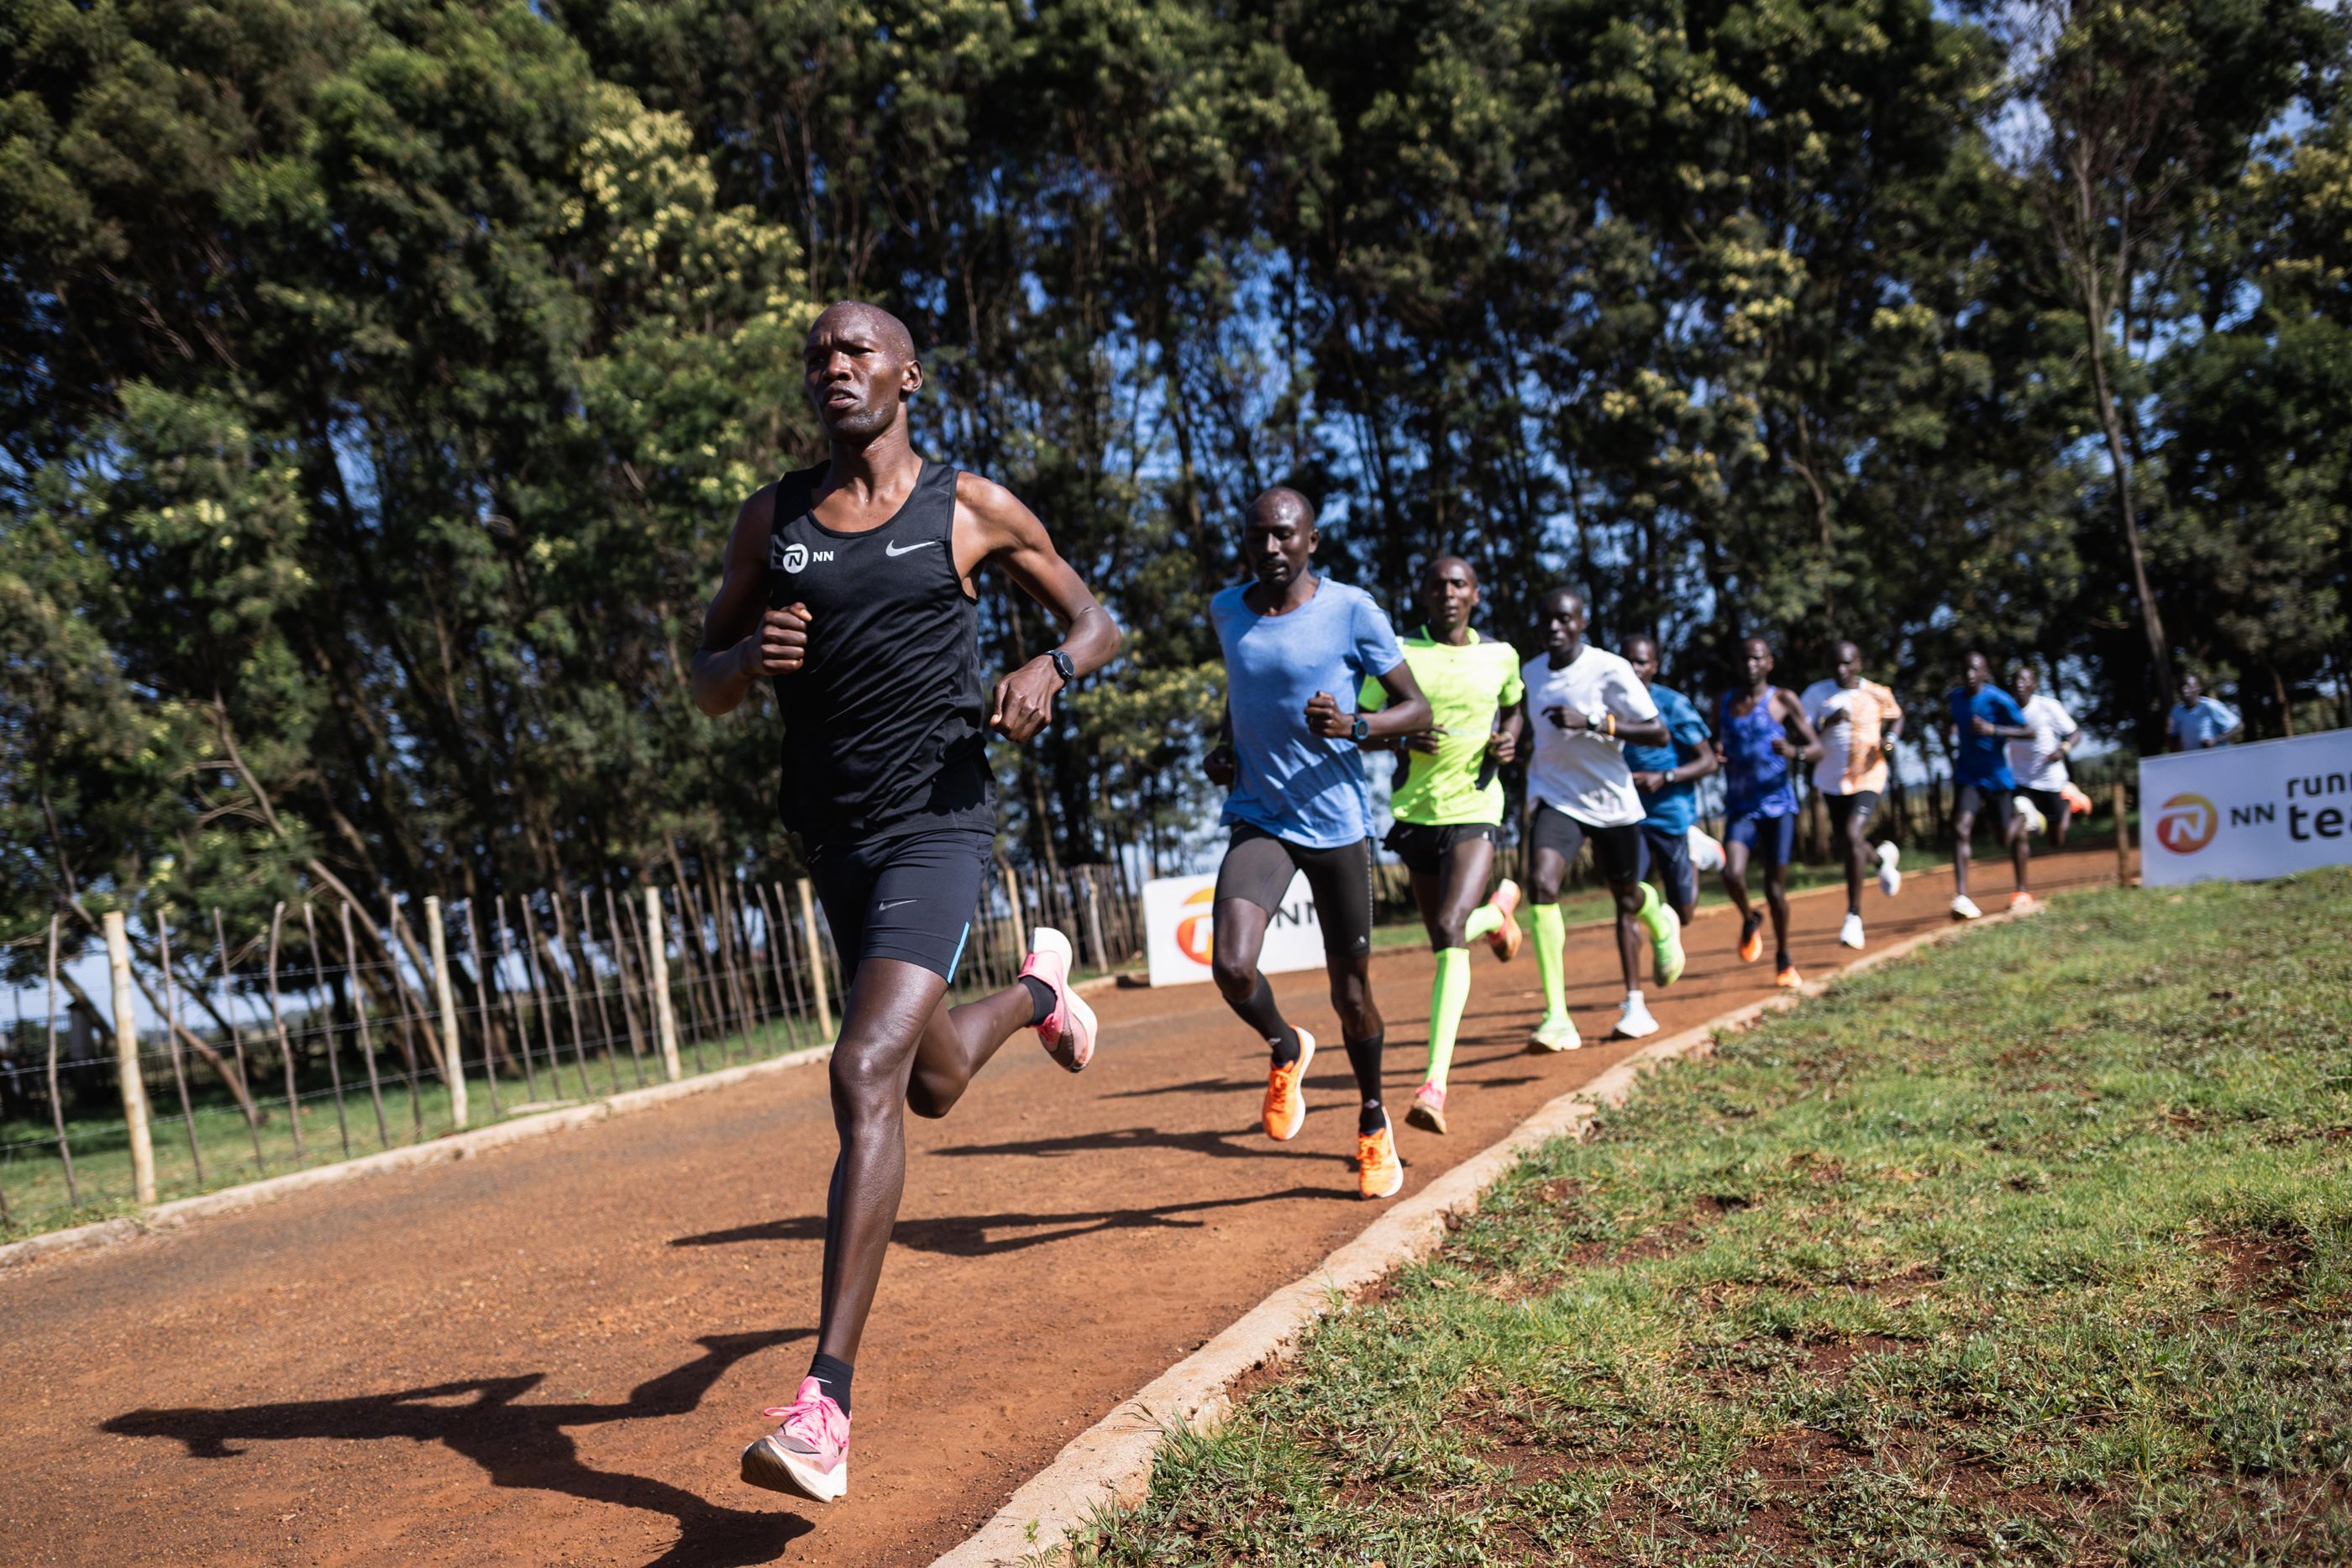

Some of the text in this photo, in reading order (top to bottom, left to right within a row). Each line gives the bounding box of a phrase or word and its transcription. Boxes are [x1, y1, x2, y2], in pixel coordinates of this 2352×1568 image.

[812, 551, 834, 562] NN
[2286, 772, 2352, 800] run
[2230, 802, 2275, 827] NN
[2288, 804, 2352, 842] te
